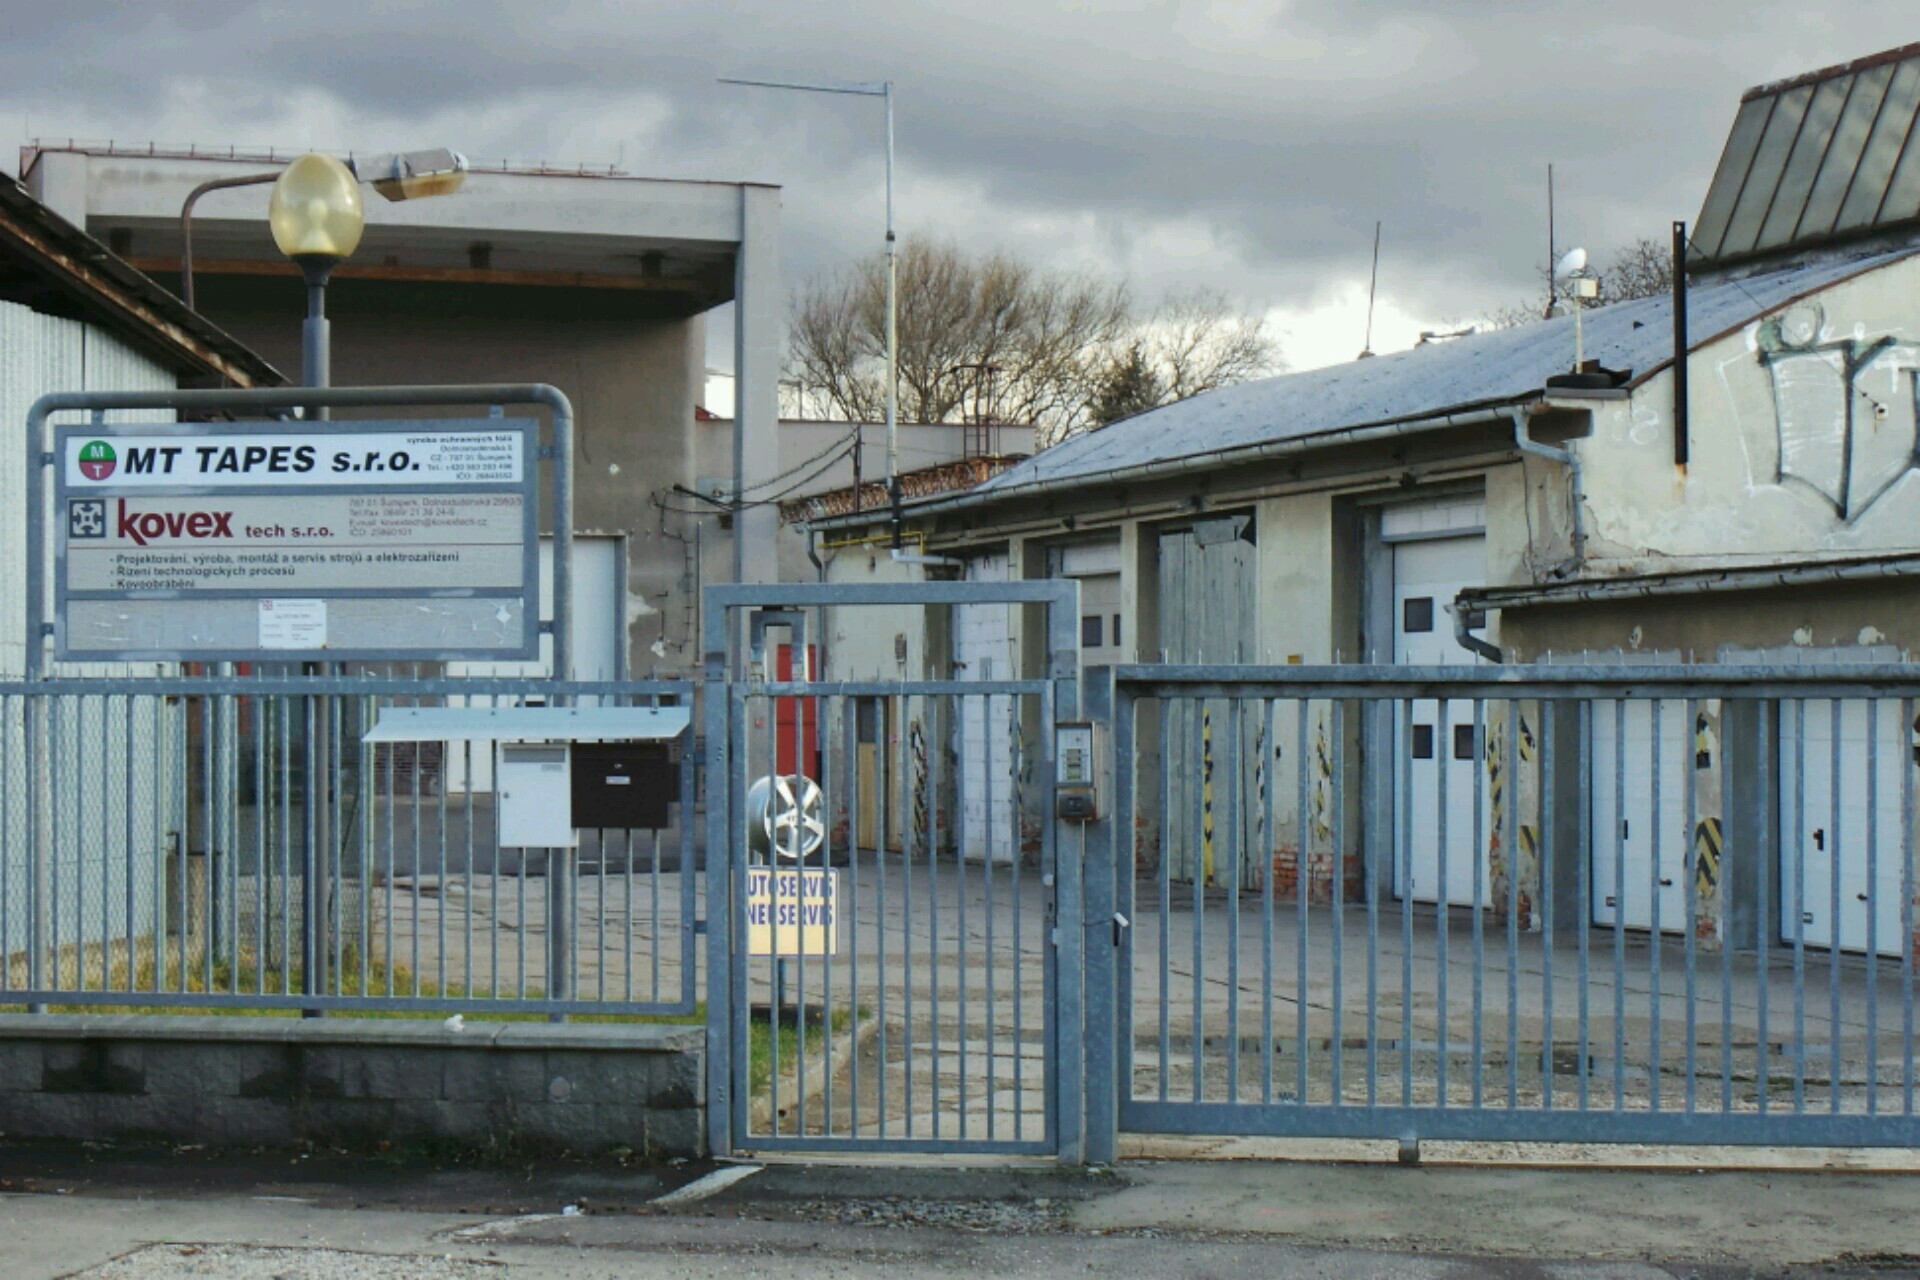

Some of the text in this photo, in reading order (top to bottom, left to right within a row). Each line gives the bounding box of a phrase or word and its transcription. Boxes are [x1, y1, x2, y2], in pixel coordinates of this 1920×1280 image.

[124, 445, 420, 474] MT TAPES s.r.o.
[117, 497, 335, 546] kovex tech s.r.o.
[237, 552, 278, 564] montáž
[281, 554, 289, 563] a
[292, 552, 326, 563] servis
[329, 552, 362, 566] strojů
[366, 554, 373, 562] a
[153, 566, 245, 579] technologických
[249, 565, 296, 578] procesů
